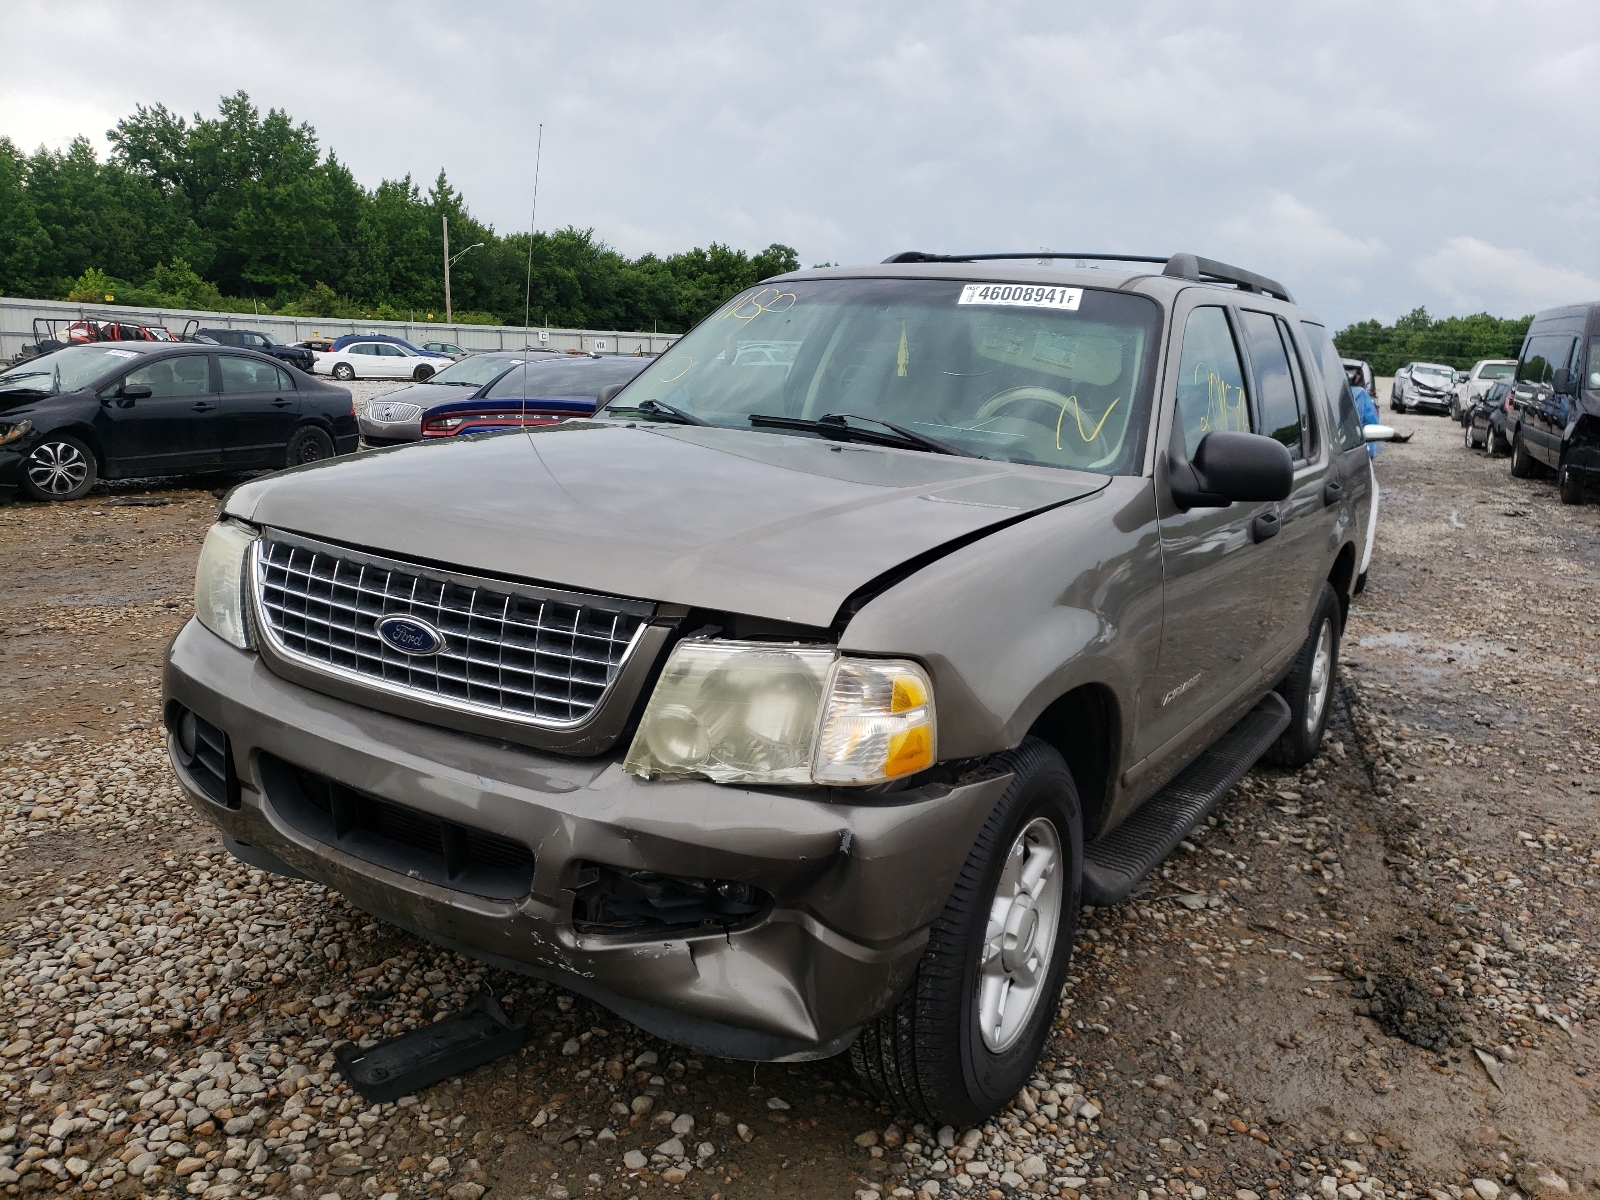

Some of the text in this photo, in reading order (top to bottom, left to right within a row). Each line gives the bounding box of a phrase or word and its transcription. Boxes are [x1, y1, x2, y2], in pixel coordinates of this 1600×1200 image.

[979, 286, 1075, 304] 46008941 F
[392, 624, 424, 646] Ford
